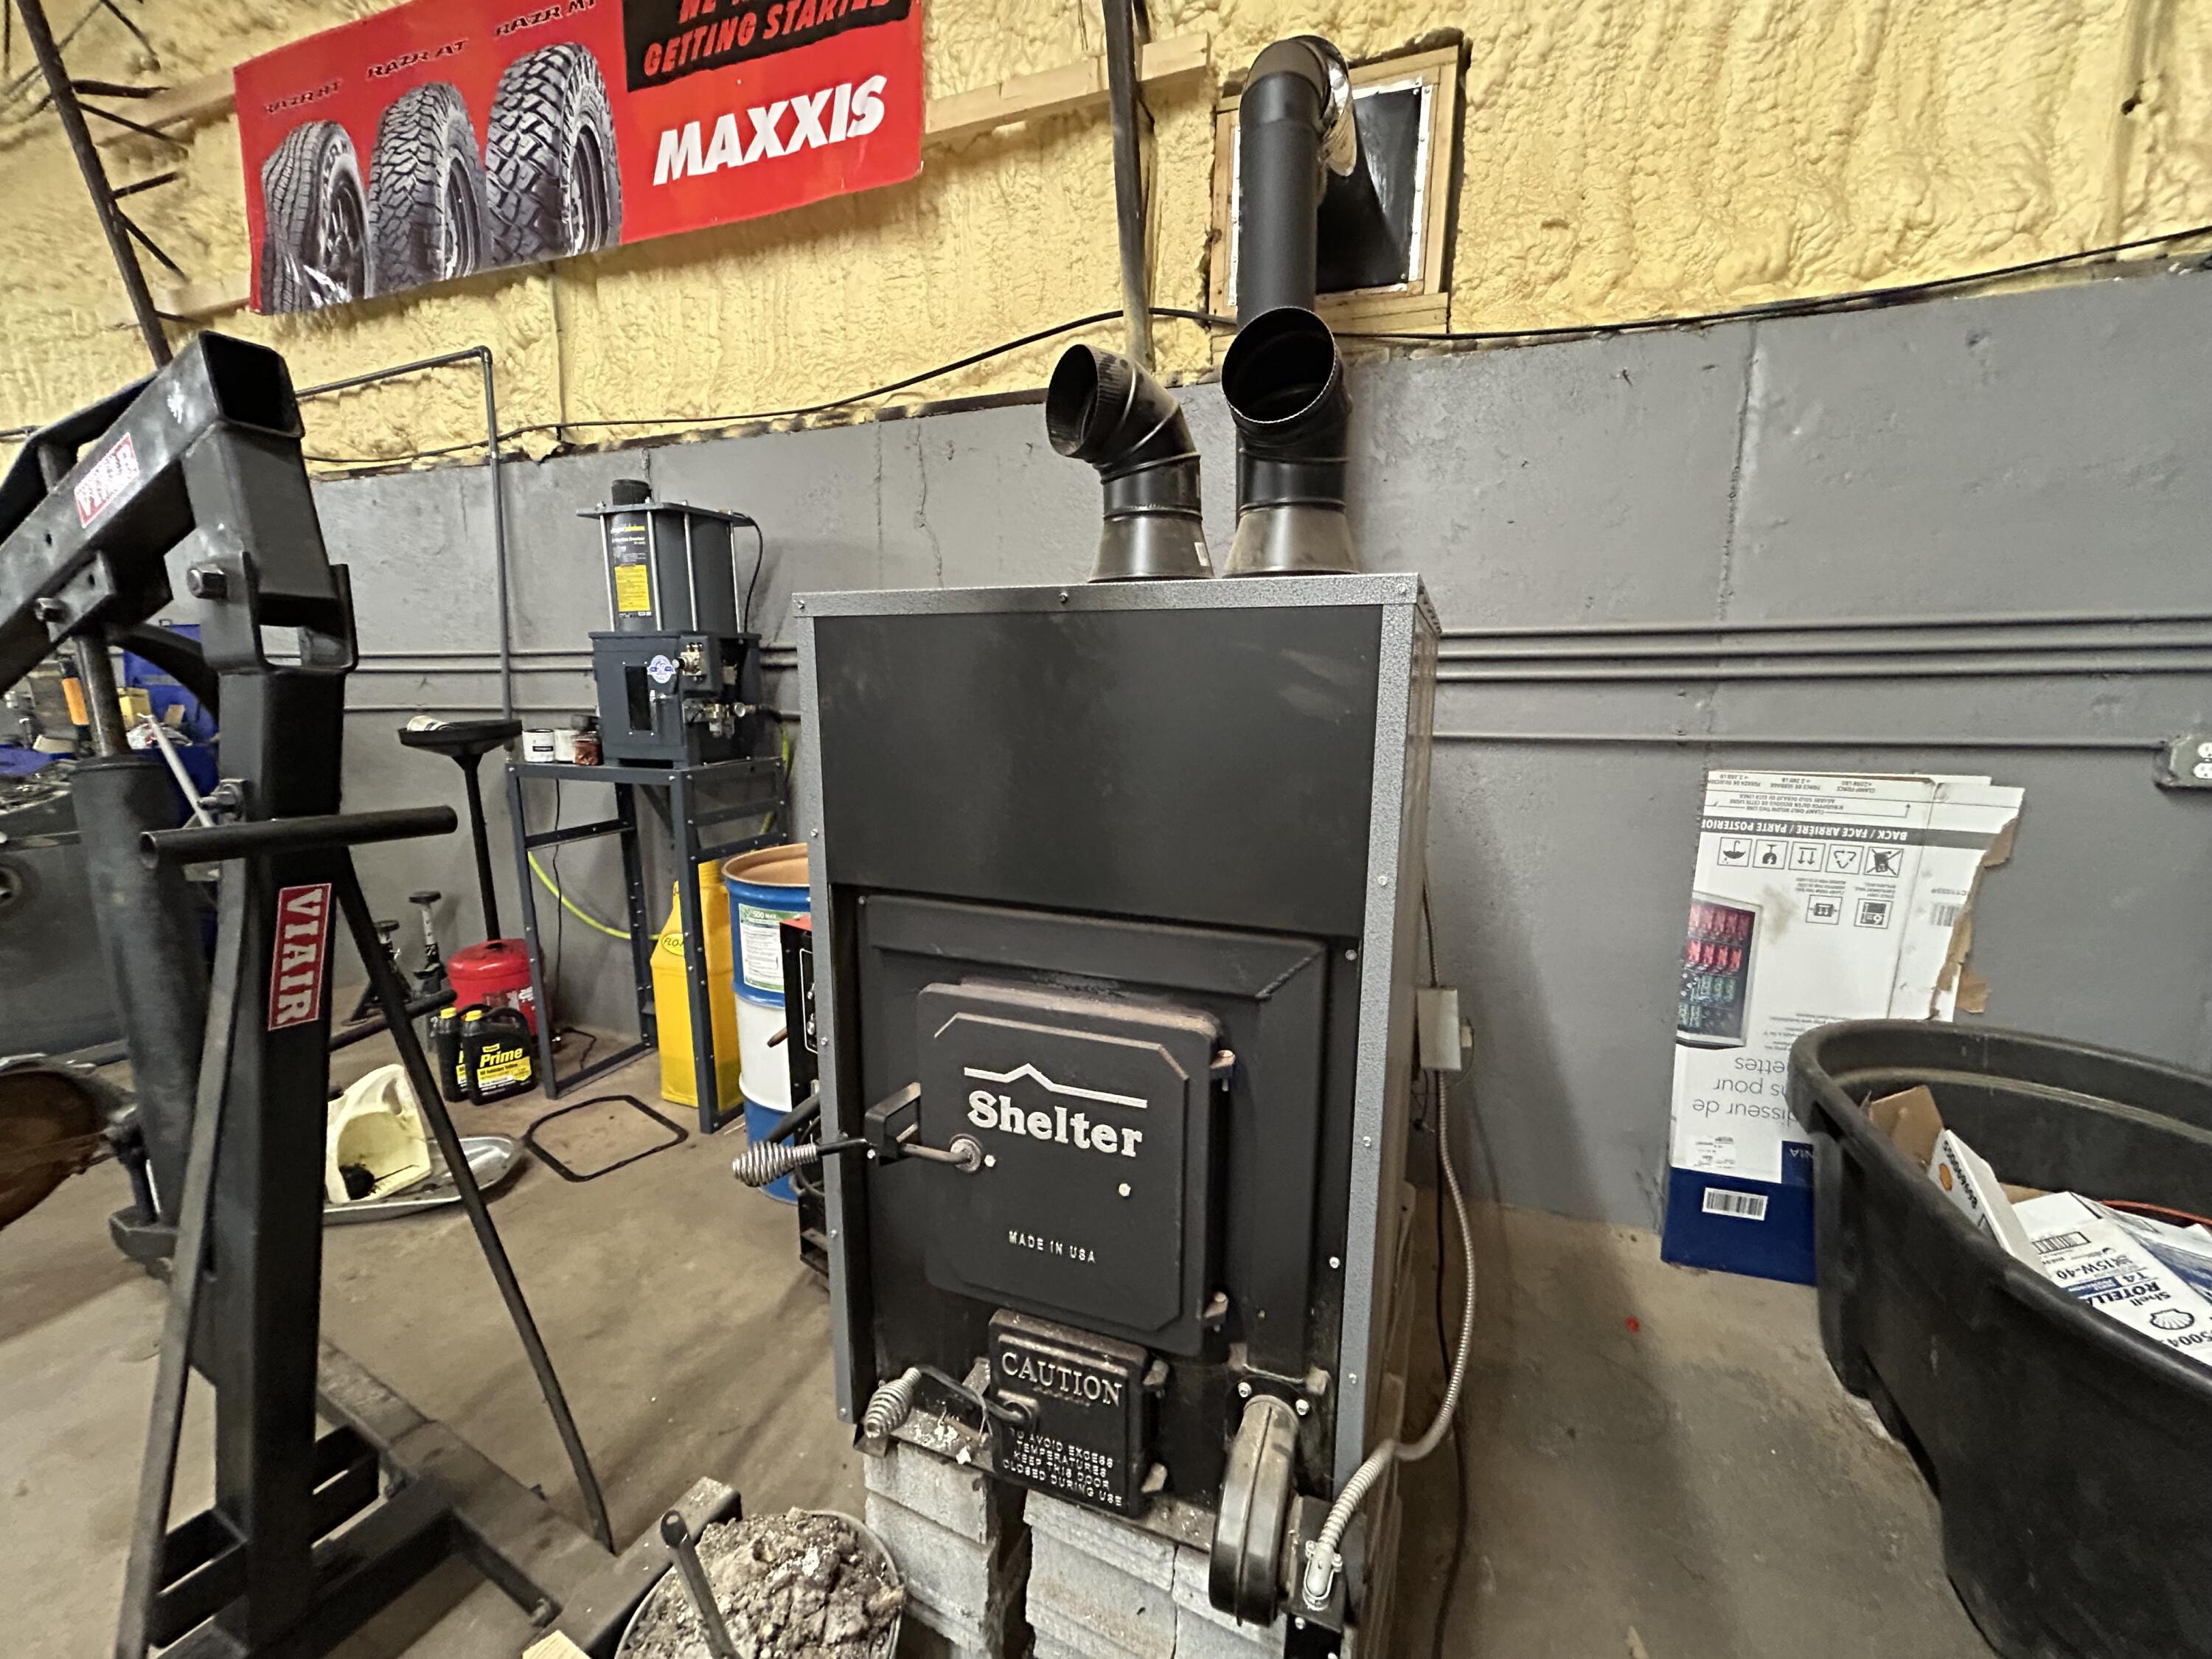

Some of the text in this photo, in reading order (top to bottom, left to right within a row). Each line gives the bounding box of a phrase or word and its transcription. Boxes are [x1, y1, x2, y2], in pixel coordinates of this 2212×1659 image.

[644, 12, 757, 76] GETTING
[762, 0, 890, 39] START
[653, 75, 887, 186] MAXXIS
[1756, 822, 1787, 833] PARTE
[1842, 827, 1868, 839] FACE
[1879, 829, 1907, 841] BACK
[276, 888, 323, 1025] VIAIR
[479, 1048, 523, 1068] Prime
[1713, 1077, 1764, 1095] pour
[967, 1090, 1142, 1158] Shelter
[1692, 1099, 1720, 1118] de
[1009, 1230, 1096, 1264] MADE IN USA
[2122, 1272, 2148, 1283] T4
[2129, 1291, 2171, 1307] Shell
[1001, 1352, 1123, 1407] CAUTION
[1016, 1440, 1107, 1478] TEMPERATURES
[1029, 1433, 1062, 1452] AVOID
[1068, 1445, 1113, 1468] EXCESS
[1003, 1458, 1122, 1506] CLOSED DURING USE
[1013, 1450, 1110, 1490] KEEP THIS DOOR
